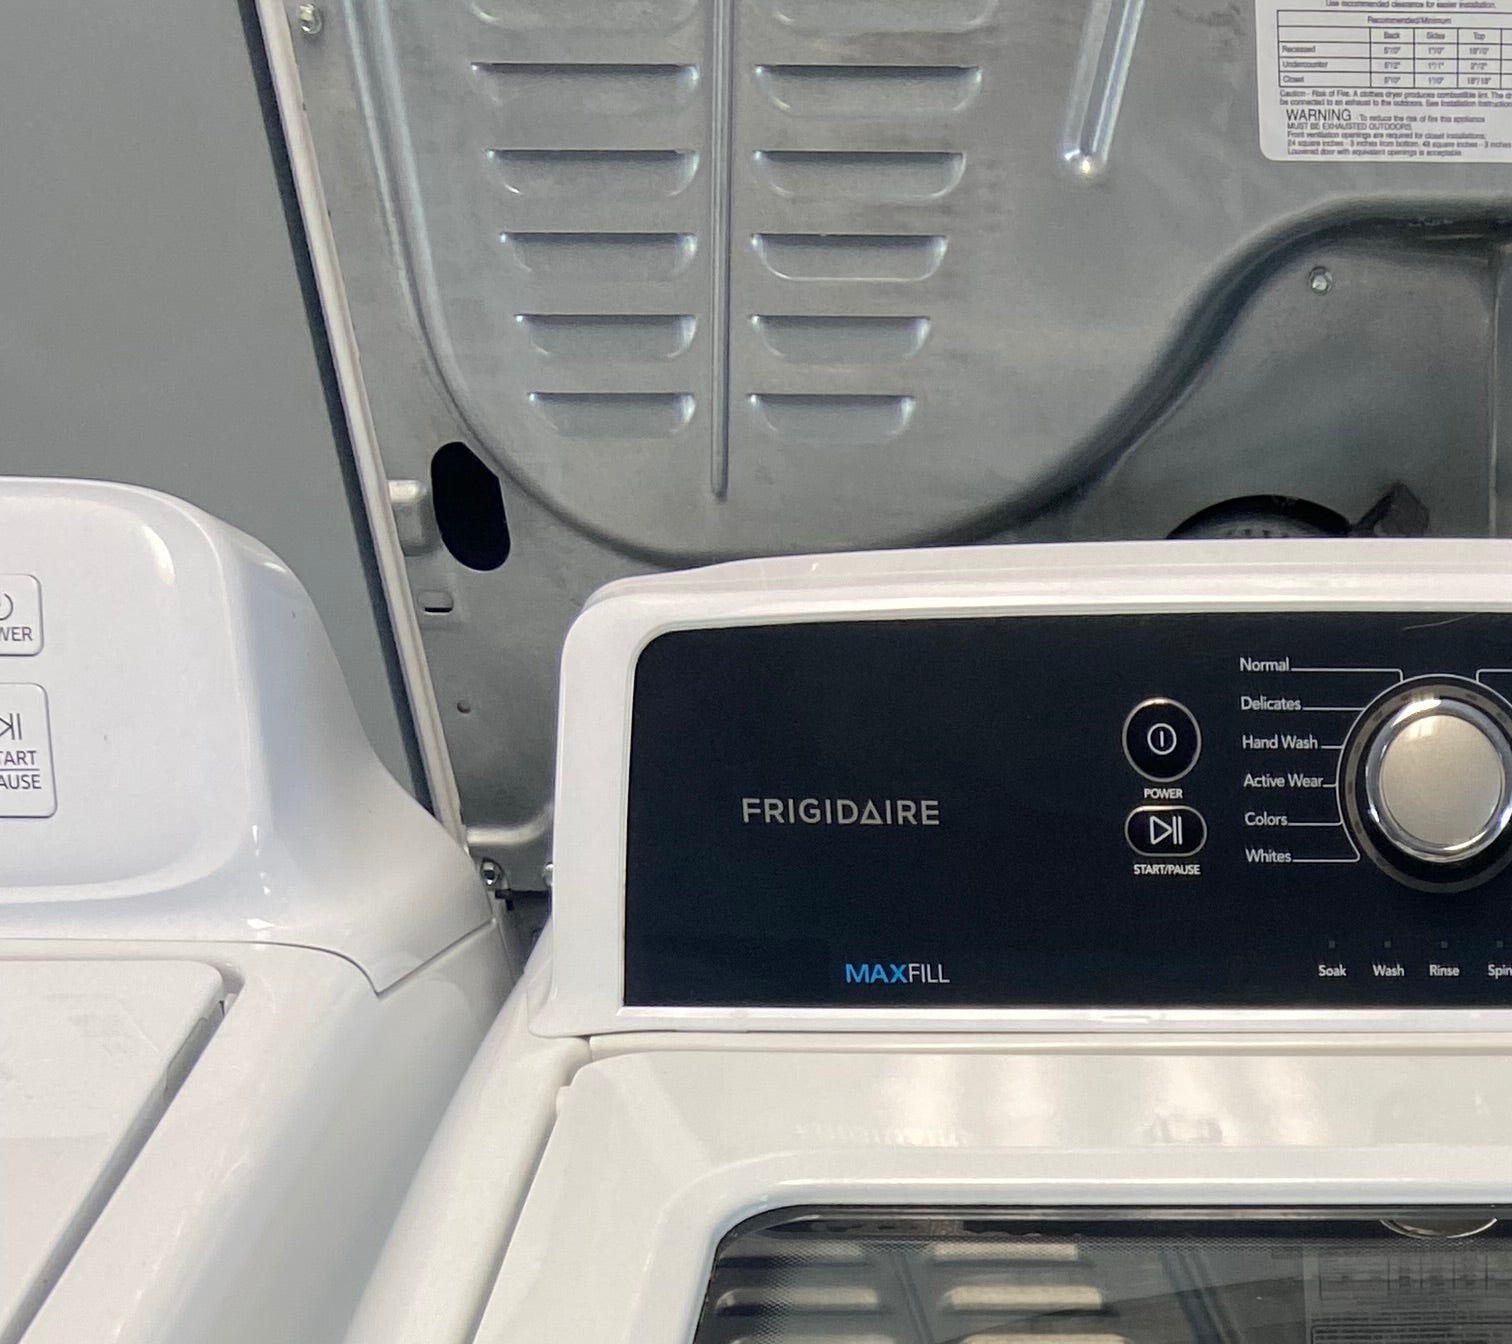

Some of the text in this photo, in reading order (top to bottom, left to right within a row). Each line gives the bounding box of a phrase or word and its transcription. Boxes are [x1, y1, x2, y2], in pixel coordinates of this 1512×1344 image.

[1473, 32, 1486, 41] Top
[1286, 108, 1352, 121] WARNING
[1240, 657, 1290, 672] Normal
[1241, 697, 1302, 711] Delicates
[1242, 736, 1318, 750] Hand Wash
[1243, 774, 1324, 788] Active Wear
[1144, 788, 1184, 800] POWER
[742, 797, 941, 826] FRIGIDAIRE
[1244, 811, 1288, 827] Colors
[1246, 849, 1293, 864] Whites
[1133, 864, 1202, 876] START/PAUSE
[845, 963, 950, 984] MAXFILL
[1318, 963, 1348, 977] Soak
[1373, 963, 1405, 977] Wash
[1429, 963, 1460, 977] Rinse
